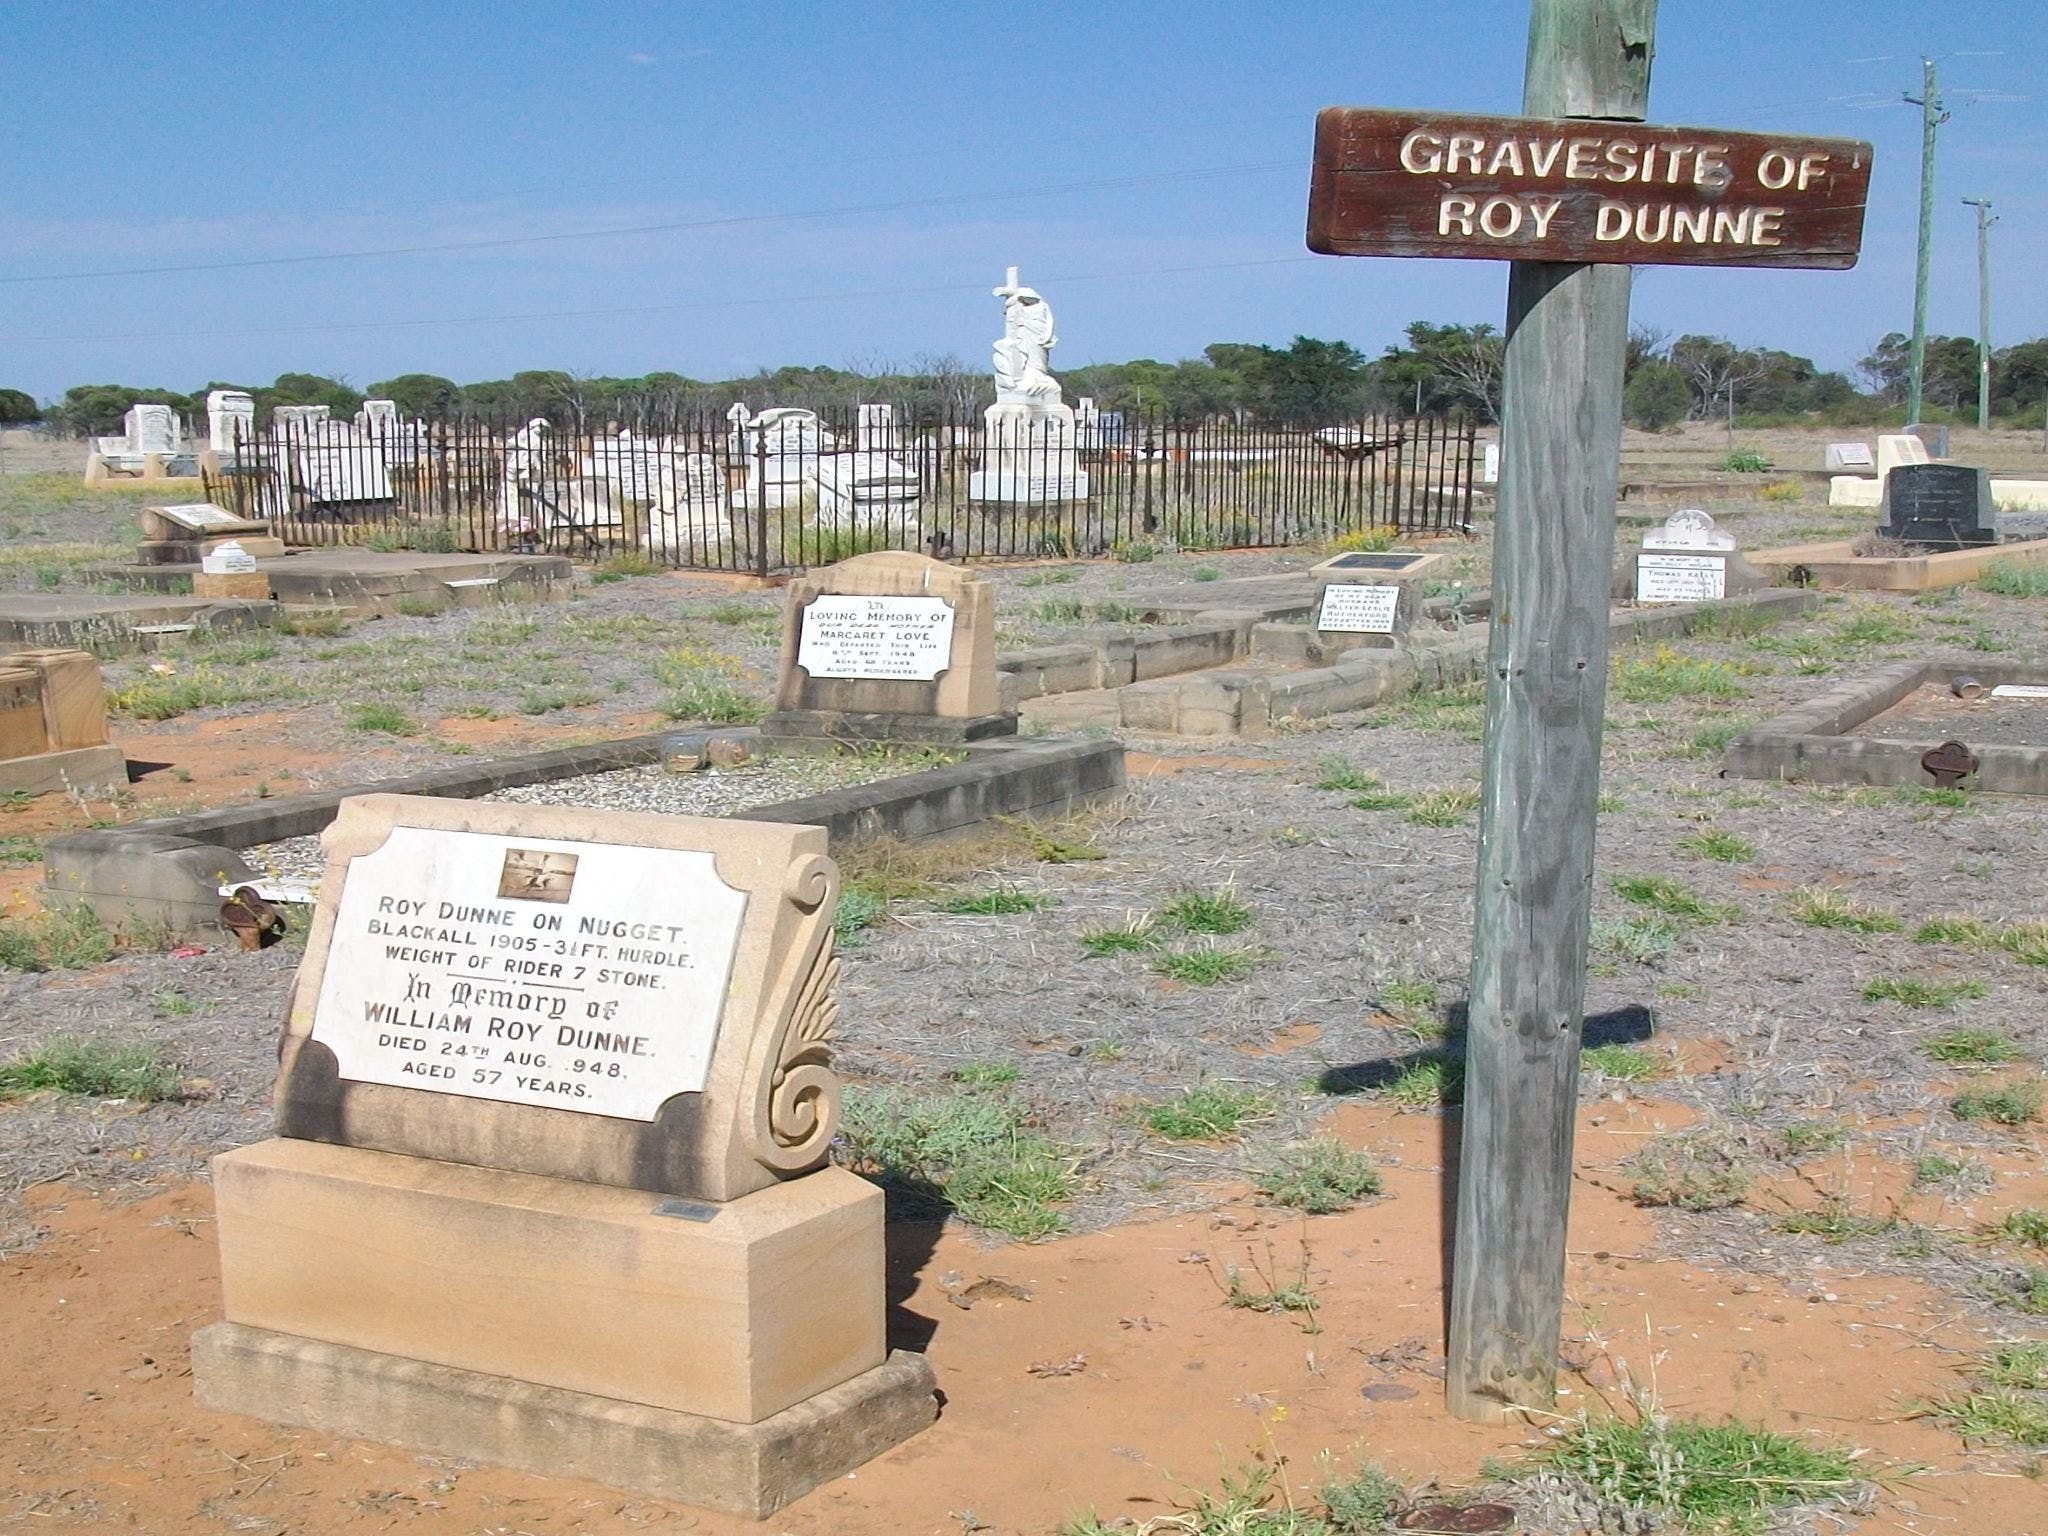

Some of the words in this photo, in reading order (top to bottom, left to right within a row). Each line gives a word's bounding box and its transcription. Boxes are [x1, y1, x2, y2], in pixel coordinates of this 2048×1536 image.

[1400, 128, 1731, 188] GRAVESITE
[1758, 148, 1830, 191] OF
[1438, 195, 1562, 239] ROY
[1595, 201, 1786, 246] DUNNE
[809, 611, 857, 621] LOVING
[867, 612, 922, 622] MEMORY
[930, 613, 948, 622] OF
[820, 630, 886, 640] MARGARET
[896, 632, 930, 641] LOVE
[368, 918, 478, 946] BLACKALL
[617, 947, 696, 970] HURDLE.
[378, 896, 428, 917] ROY
[438, 901, 517, 927] DUNNE
[533, 912, 563, 931] ON
[578, 916, 688, 945] NUGGET.
[385, 945, 457, 966] WEIGHT
[467, 955, 492, 970] OF
[504, 958, 563, 978] RIDER
[573, 966, 587, 981] 7
[597, 968, 667, 990] STONE.
[402, 972, 431, 1003] In
[449, 982, 567, 1021] Memory
[585, 999, 619, 1021] of
[364, 1000, 473, 1034] WILLIAM
[487, 1017, 543, 1042] ROY
[557, 1025, 657, 1058] DUNNE.
[378, 1033, 427, 1052] DIED
[440, 1041, 490, 1060] 24TH
[503, 1050, 551, 1068] AUG.
[401, 1061, 456, 1079] AGED
[472, 1067, 502, 1085] 57
[516, 1075, 593, 1099] YEARS.
